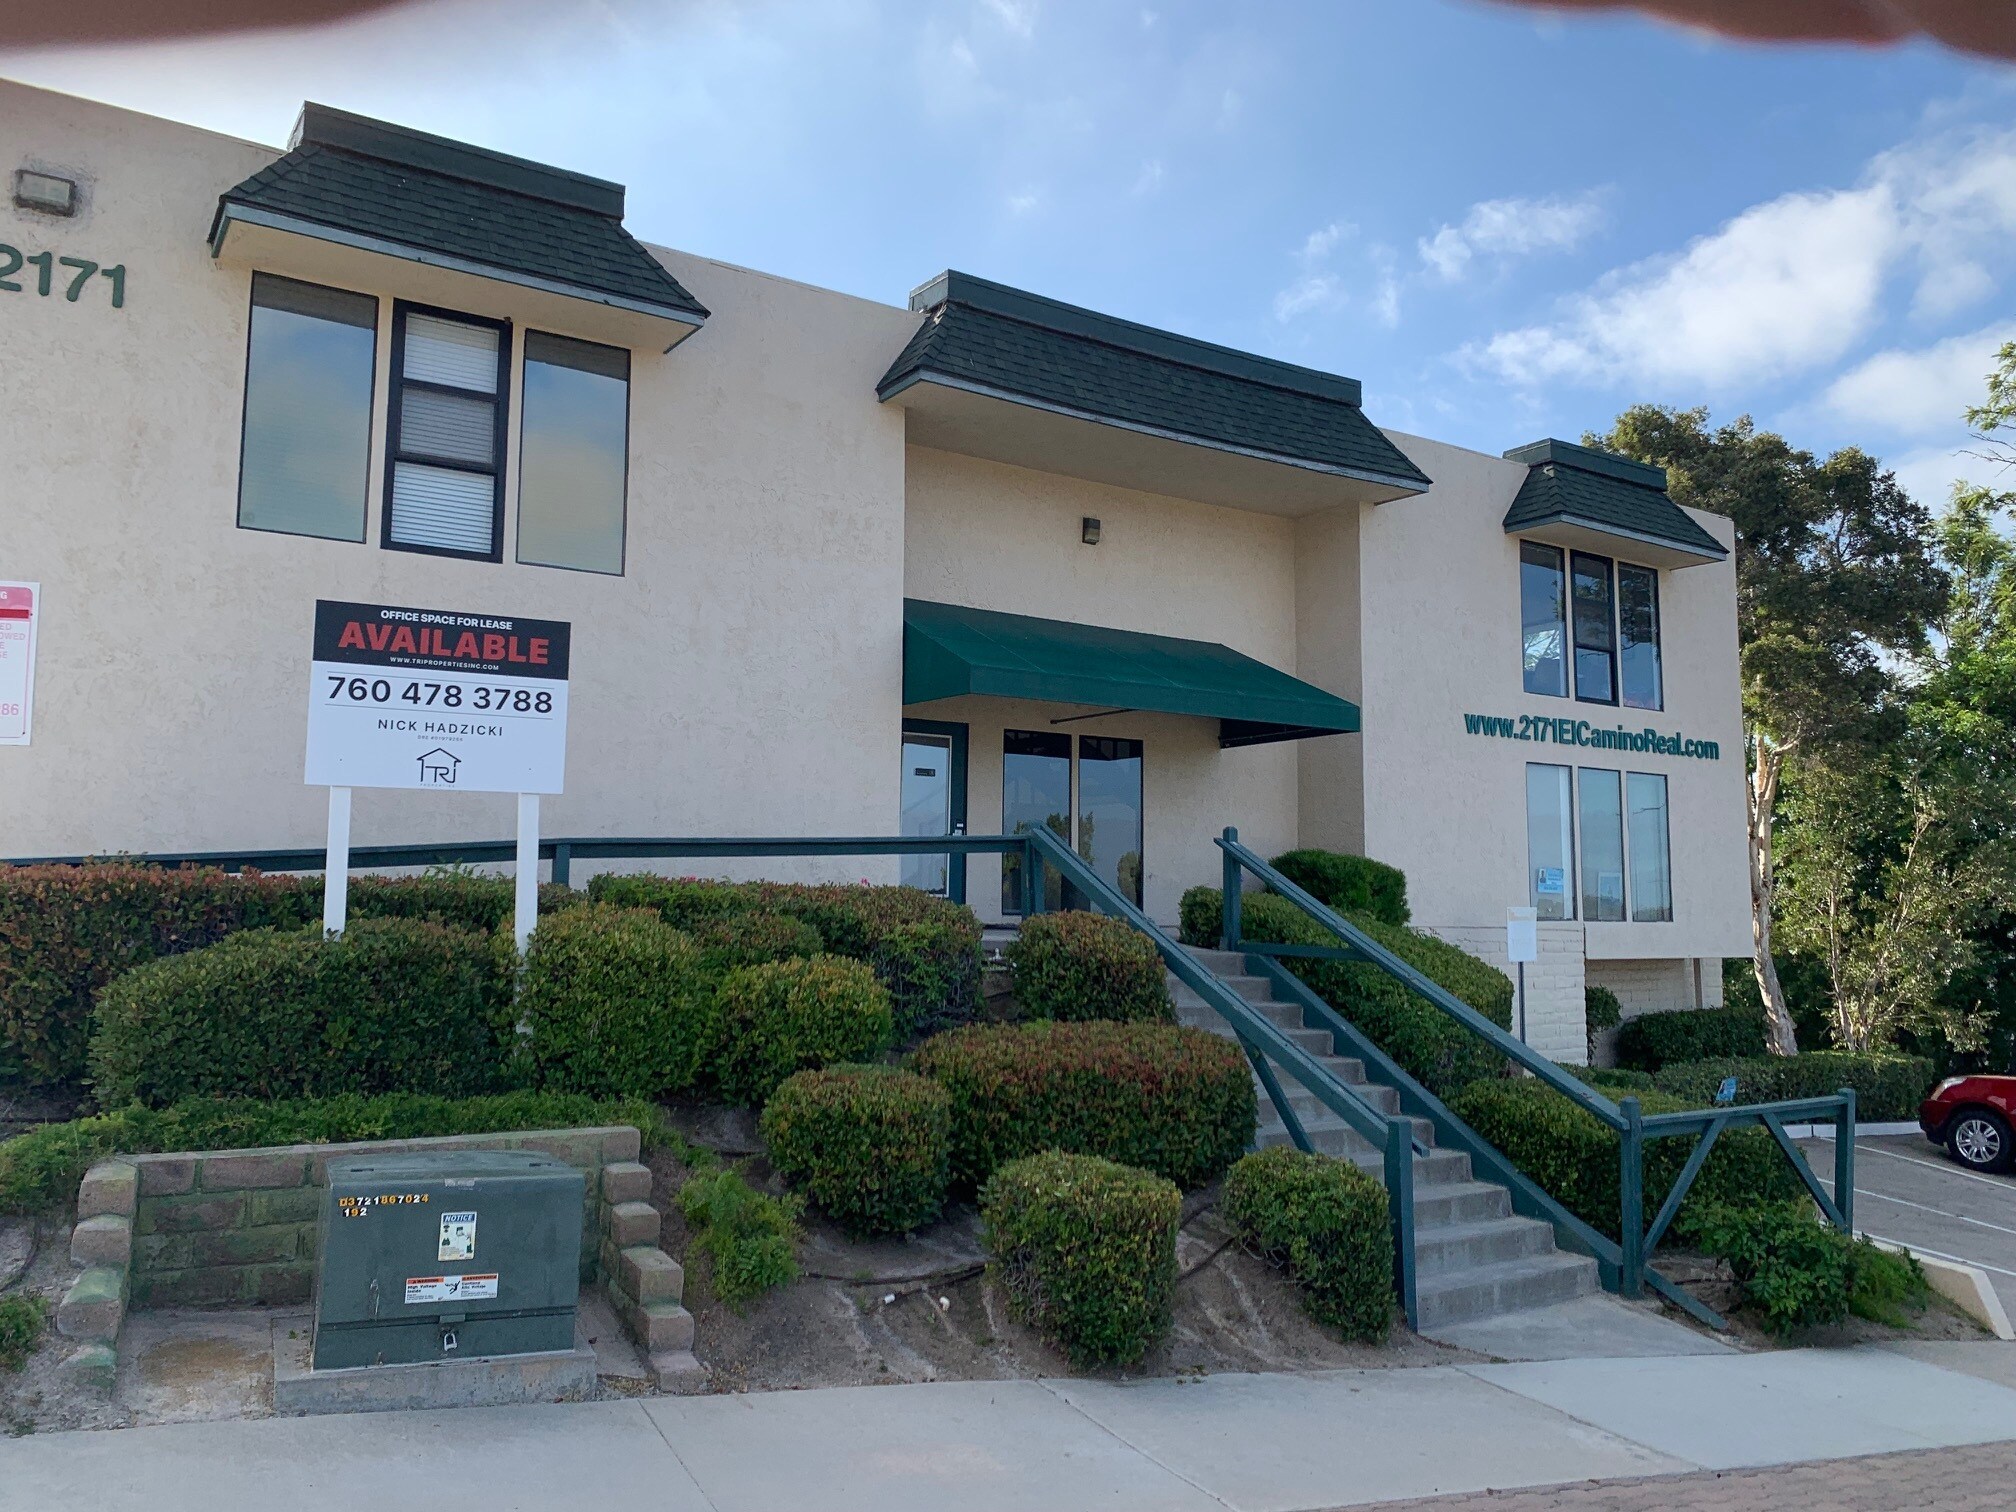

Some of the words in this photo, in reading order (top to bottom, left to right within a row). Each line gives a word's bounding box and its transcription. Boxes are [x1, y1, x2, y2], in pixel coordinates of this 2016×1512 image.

[0, 243, 126, 309] 2171
[380, 609, 419, 622] OFFICE
[420, 613, 456, 625] SPACE
[457, 617, 479, 628] FOR
[480, 620, 513, 630] LEASE
[337, 621, 550, 665] AVAILABLE
[389, 656, 499, 671] WWW.TRIPROPERTIESINC.COM
[327, 676, 391, 703] 760
[401, 682, 462, 708] 478
[472, 687, 553, 714] 3788
[377, 719, 418, 732] NICK
[424, 722, 503, 737] HADZICKI
[343, 1207, 367, 1217] 192
[445, 1214, 473, 1222] NOTICE
